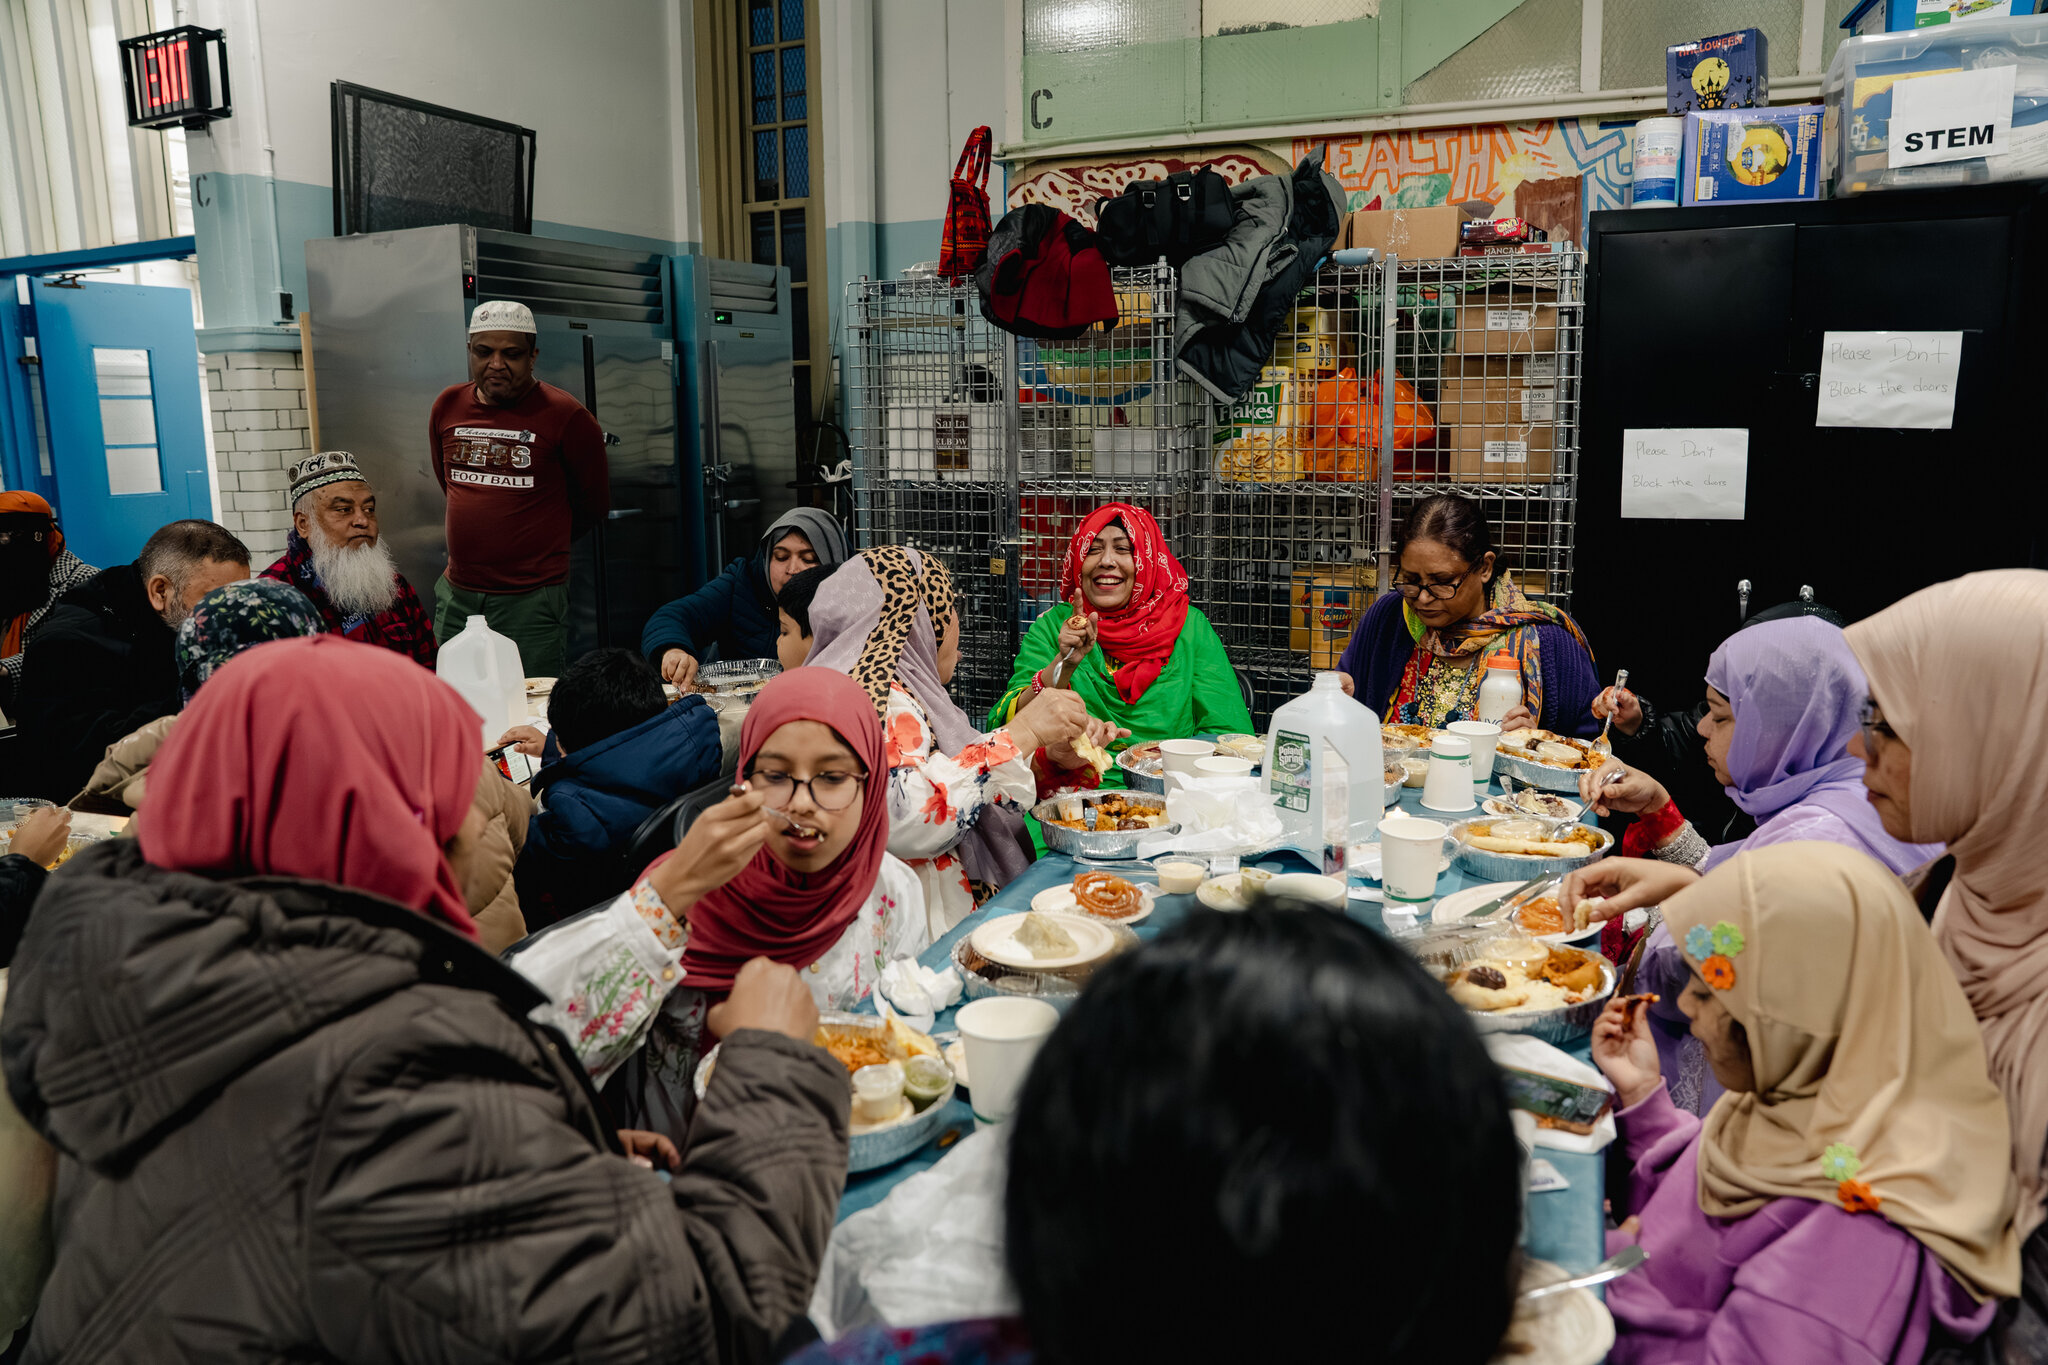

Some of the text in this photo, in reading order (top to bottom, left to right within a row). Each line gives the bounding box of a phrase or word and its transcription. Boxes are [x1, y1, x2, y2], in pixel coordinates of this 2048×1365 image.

[1679, 33, 1746, 57] HALLOWEEN
[144, 40, 189, 108] EXIT
[1031, 89, 1053, 130] C
[1904, 124, 1994, 152] STEM
[196, 174, 210, 207] C
[1484, 246, 1527, 256] MANCALA
[1831, 337, 1950, 363] Please Don't
[1828, 377, 1949, 398] Block the doors
[1240, 390, 1270, 404] orn
[1219, 404, 1275, 422] Flakes
[935, 437, 968, 446] ELBOW
[1636, 440, 1669, 460] Please
[452, 471, 531, 487] FOOT BALL
[1667, 476, 1694, 488] the
[1703, 474, 1727, 486] doors
[1312, 609, 1356, 623] Premiu
[1279, 745, 1303, 757] Poland
[1279, 755, 1304, 767] Spring
